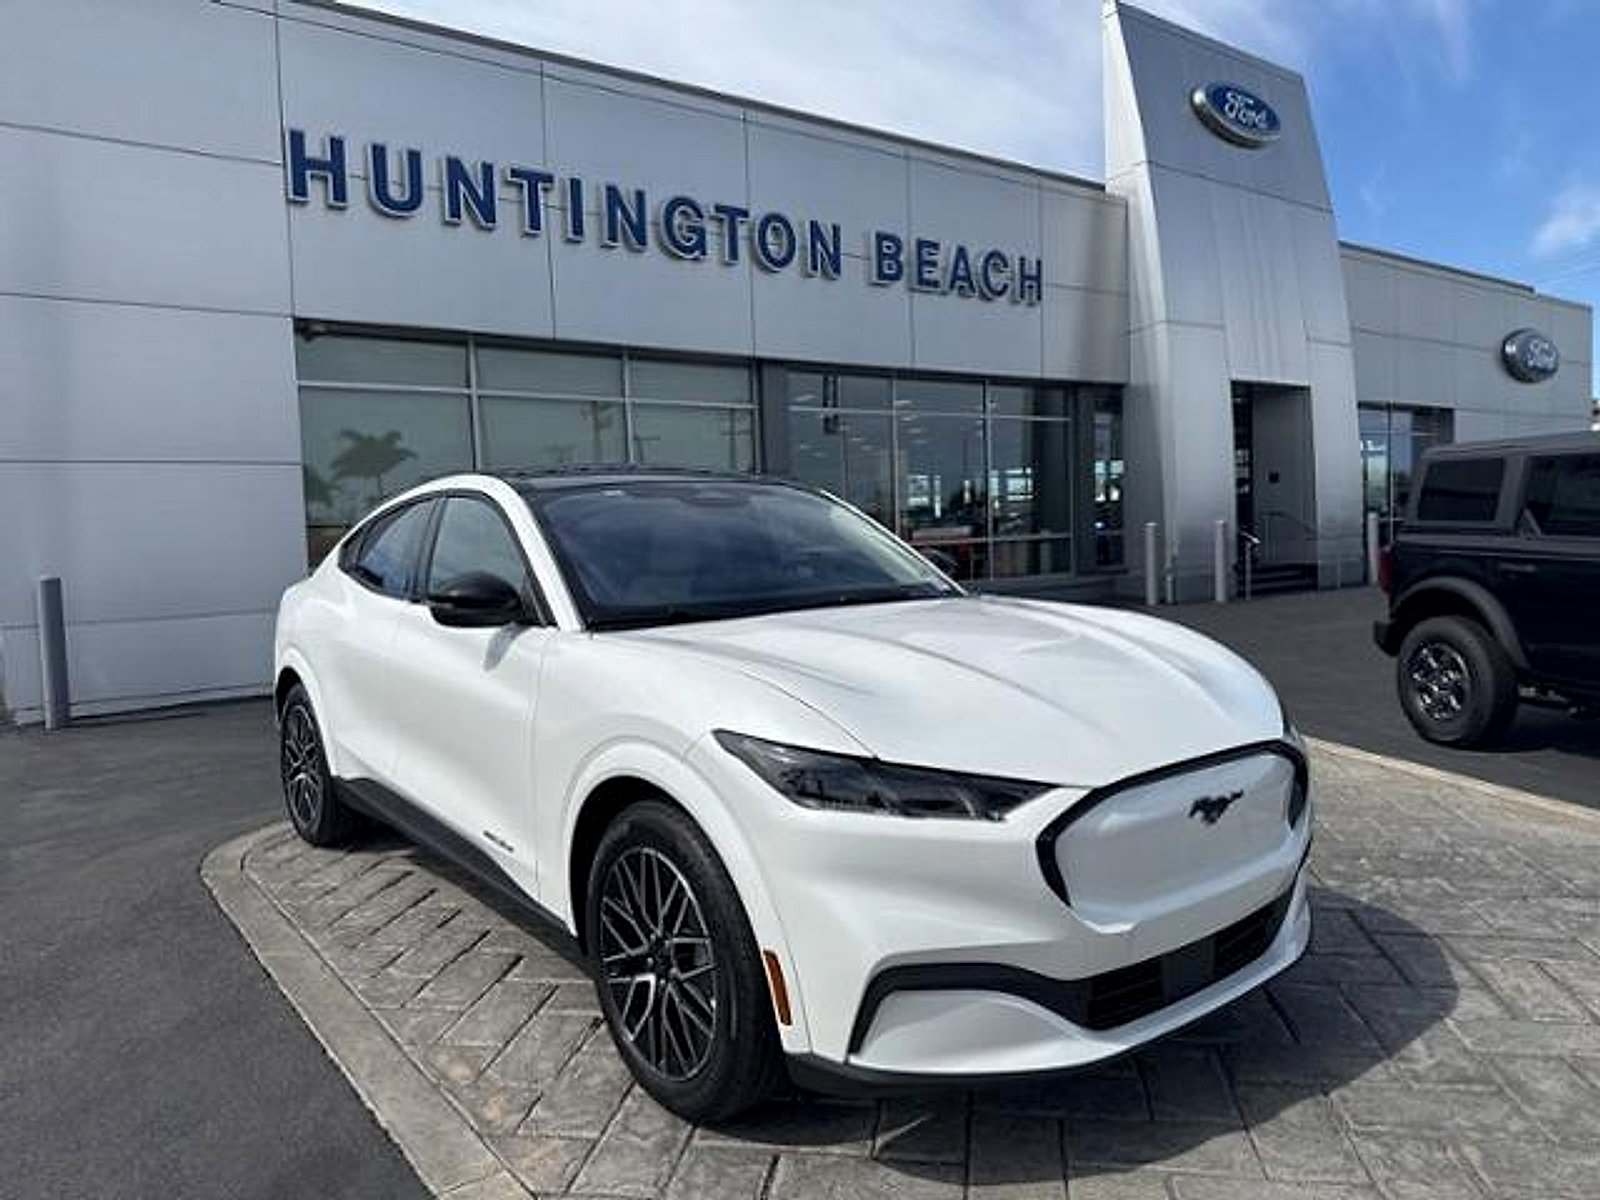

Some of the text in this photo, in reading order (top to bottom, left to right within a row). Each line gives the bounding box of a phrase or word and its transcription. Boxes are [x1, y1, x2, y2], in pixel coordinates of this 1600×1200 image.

[1222, 91, 1268, 129] Ford
[286, 128, 1044, 305] HUNTINGTON BEACH
